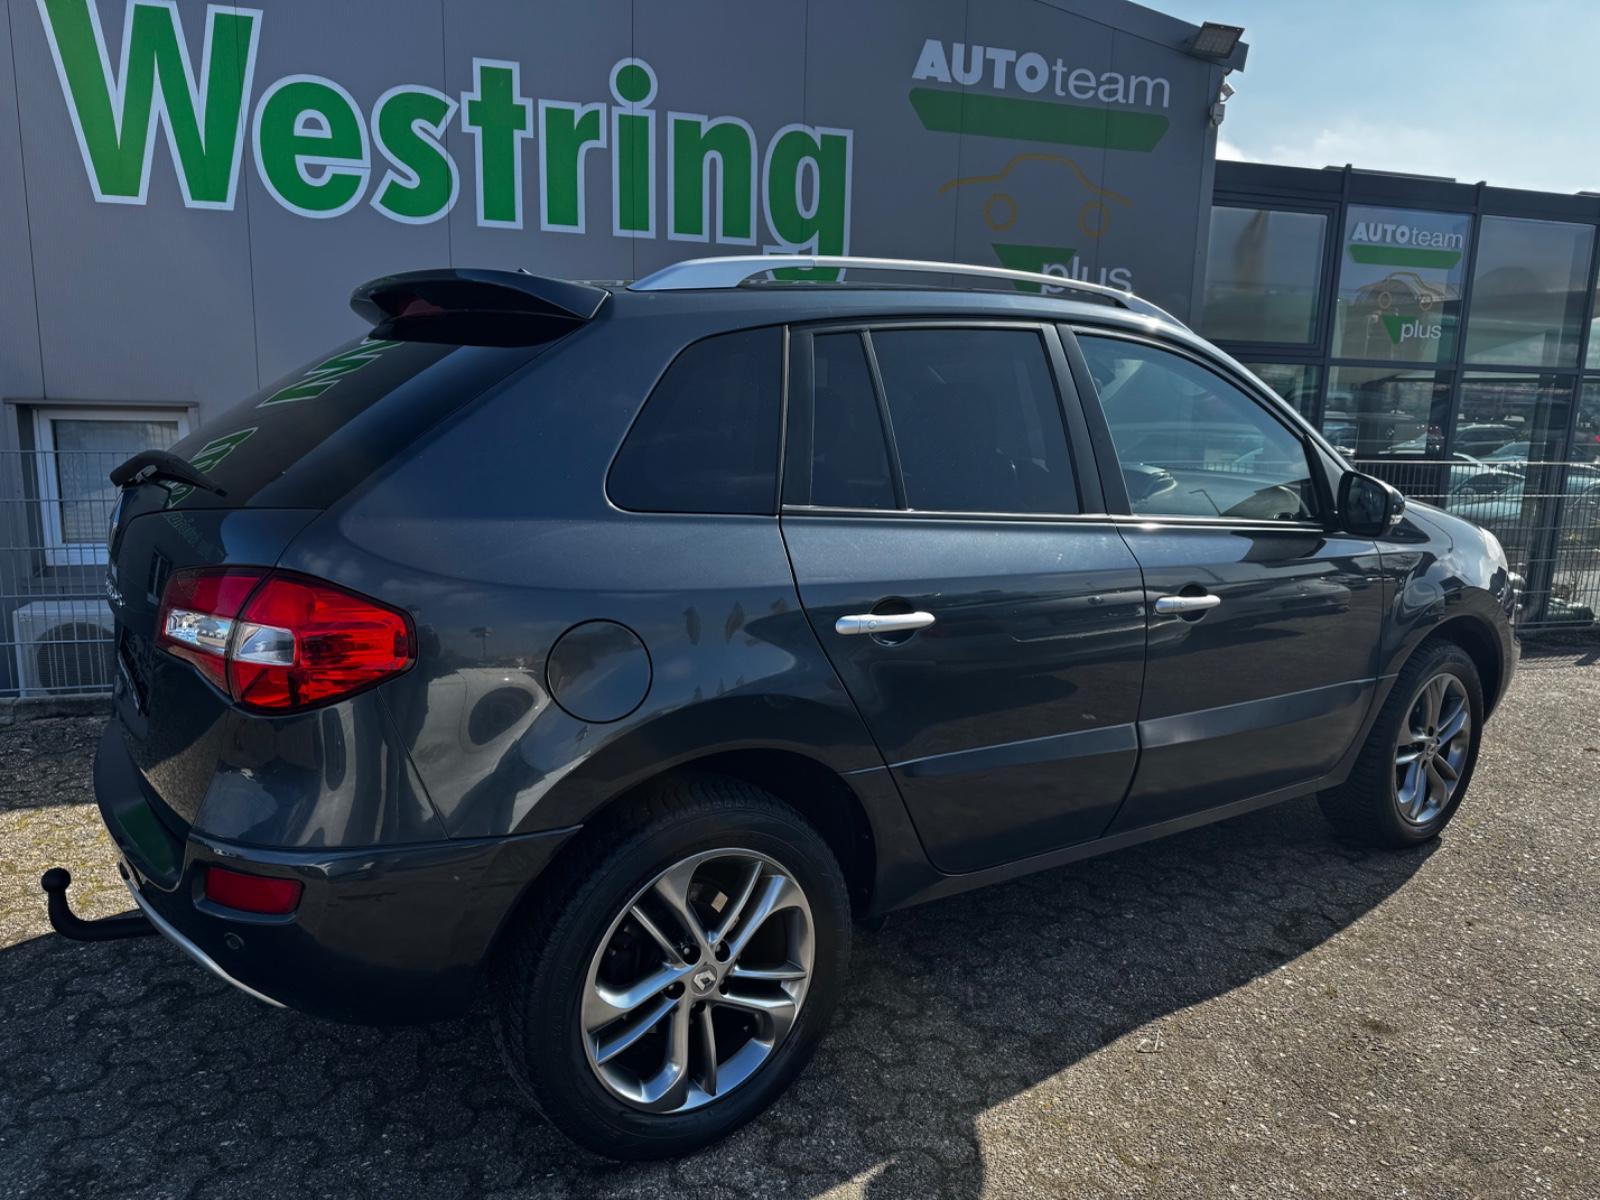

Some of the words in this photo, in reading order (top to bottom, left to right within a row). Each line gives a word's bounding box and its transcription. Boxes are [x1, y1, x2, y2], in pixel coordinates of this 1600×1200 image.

[912, 39, 1170, 108] AUTOteam
[37, 0, 854, 283] Westring
[1351, 221, 1464, 249] AUTOteam
[1400, 319, 1443, 343] plus
